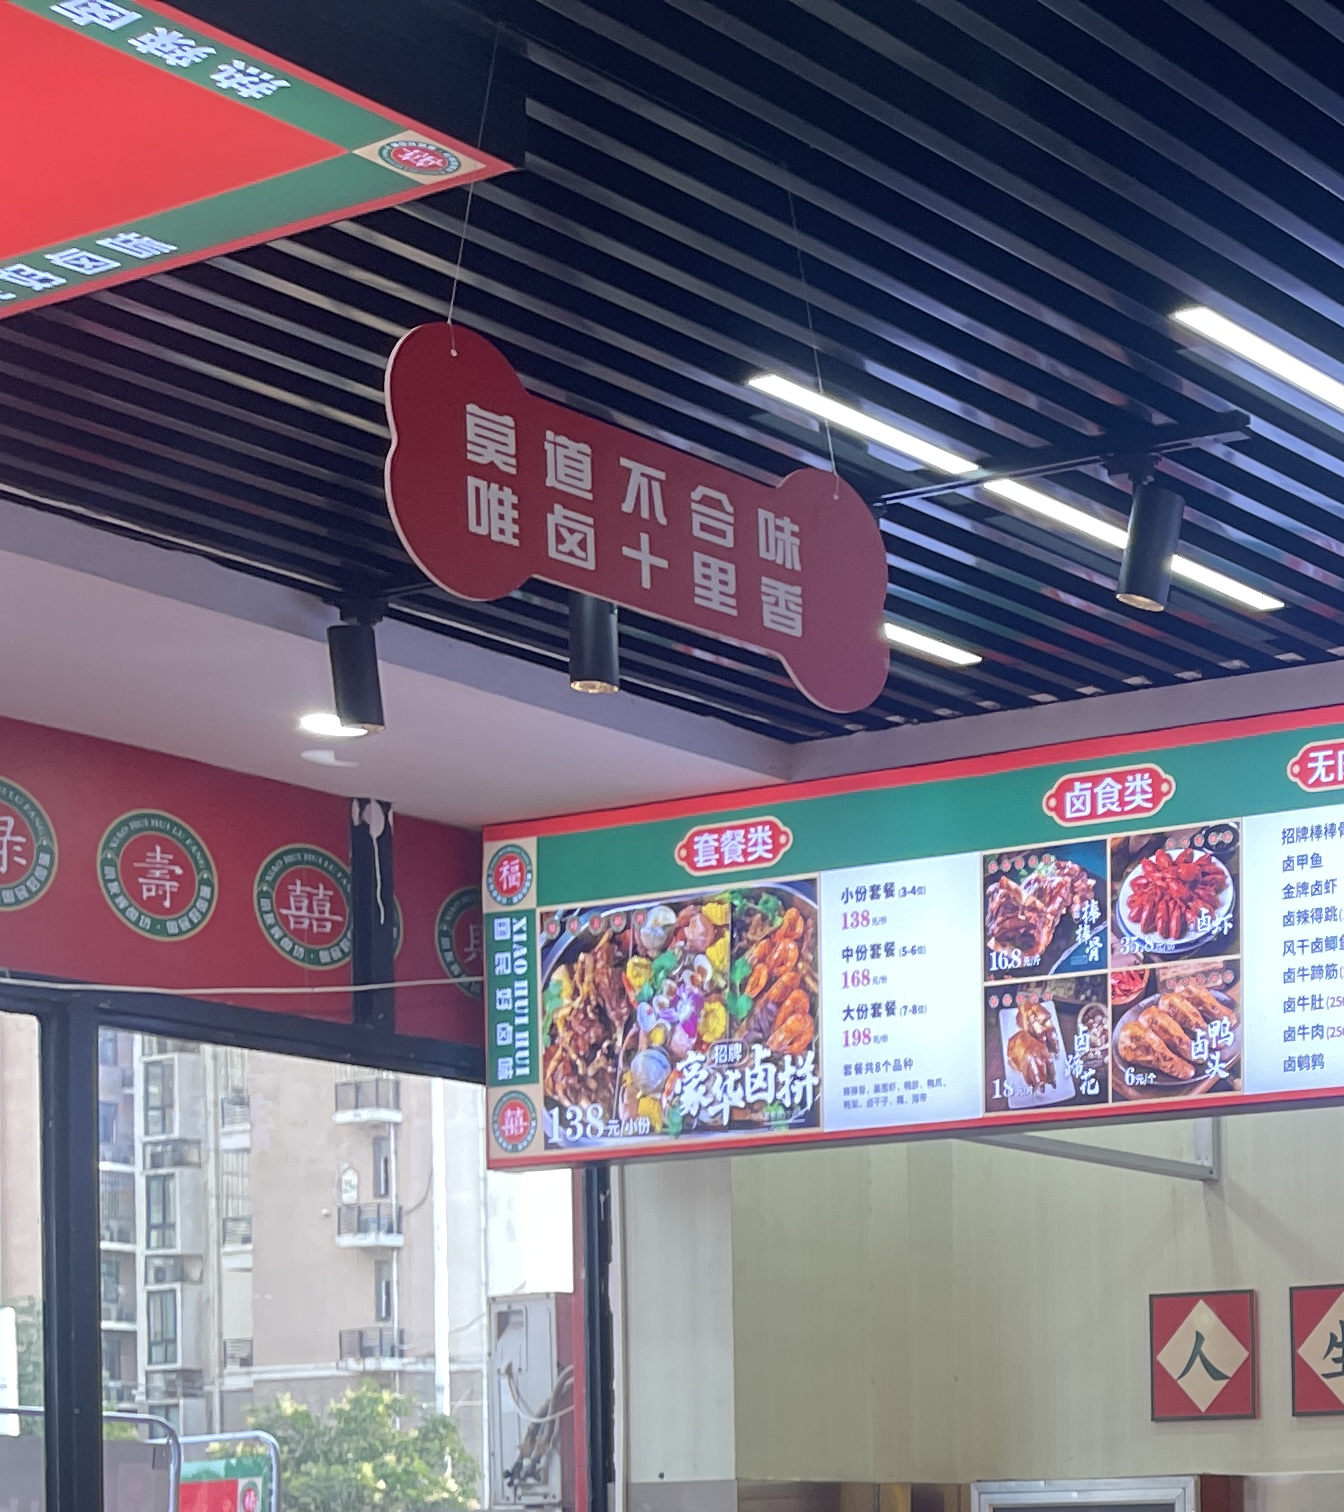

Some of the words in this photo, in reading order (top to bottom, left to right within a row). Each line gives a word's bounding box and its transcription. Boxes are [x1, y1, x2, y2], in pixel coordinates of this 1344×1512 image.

[464, 404, 802, 571] 莫道不合味
[466, 472, 803, 640] 唯卤十里香
[1065, 772, 1154, 819] 卤食类
[693, 824, 774, 869] 套餐类
[1282, 852, 1323, 873] 卤甲鱼
[841, 881, 895, 905] 小份套餐
[1282, 878, 1337, 900] 金牌卤虾
[841, 908, 871, 931] 138
[511, 915, 529, 976] XIAO
[841, 941, 895, 964] 中份套餐
[841, 968, 871, 990] 168
[513, 980, 530, 1026] HUI
[842, 1000, 897, 1022] 大份套餐
[842, 1027, 872, 1048] 198
[514, 1030, 530, 1077] HUI
[1283, 1053, 1325, 1073] 卤鹌鹑
[675, 1044, 820, 1126] 豪华卤拼
